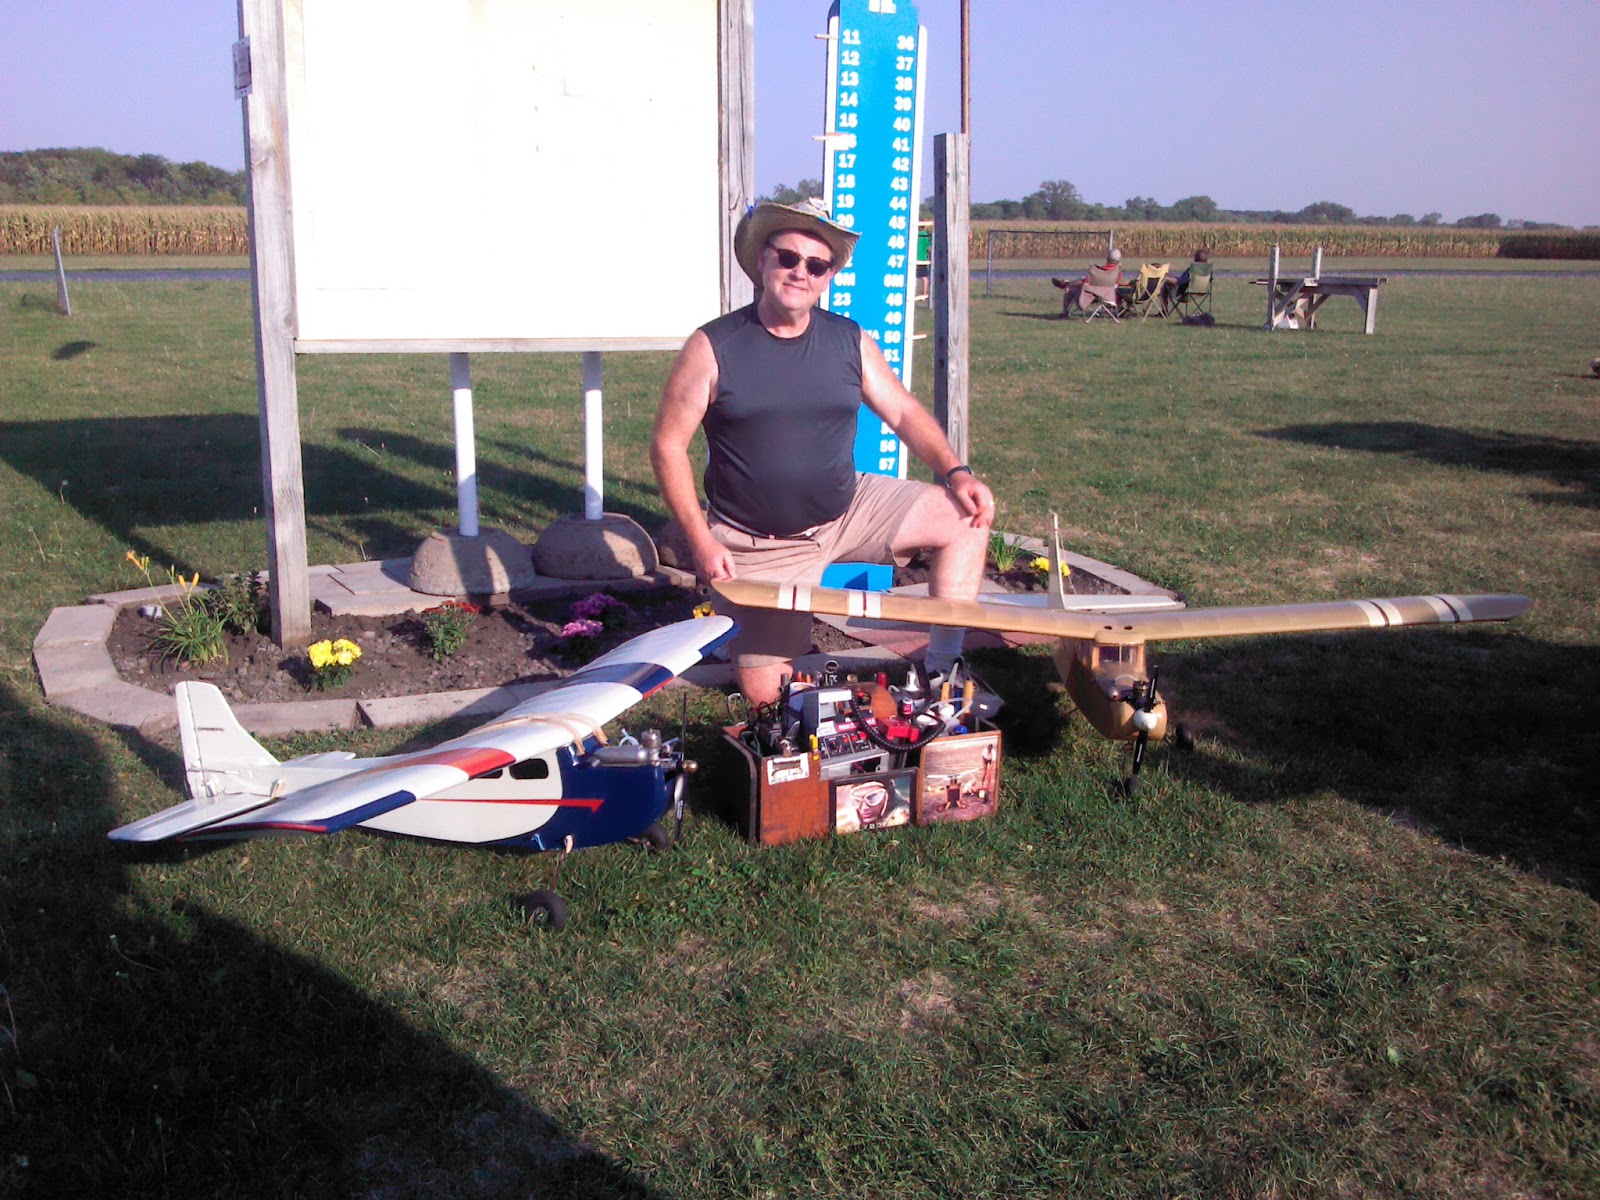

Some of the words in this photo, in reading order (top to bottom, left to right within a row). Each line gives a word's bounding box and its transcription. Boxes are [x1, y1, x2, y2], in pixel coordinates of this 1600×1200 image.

[842, 29, 861, 45] 11
[897, 36, 916, 51] 36
[841, 50, 860, 66] 12
[896, 56, 914, 70] 37
[840, 71, 859, 87] 13
[896, 76, 913, 91] 38
[840, 92, 858, 107] 14
[894, 96, 912, 111] 39
[839, 113, 858, 128] 15
[893, 117, 911, 132] 40
[892, 137, 910, 152] 41
[838, 154, 856, 169] 17
[892, 157, 910, 171] 42
[837, 174, 855, 189] 18
[890, 177, 908, 192] 43
[836, 194, 854, 209] 19
[890, 197, 907, 211] 44
[836, 214, 854, 228] 20
[889, 216, 906, 230] 45
[887, 235, 905, 249] 46
[888, 255, 905, 269] 47
[834, 272, 856, 287] 6M
[833, 292, 851, 306] 23
[886, 293, 903, 307] 48
[885, 312, 902, 325] 49
[883, 331, 901, 344] 50
[883, 348, 901, 362] 51
[879, 439, 897, 453] 56
[879, 457, 896, 470] 57
